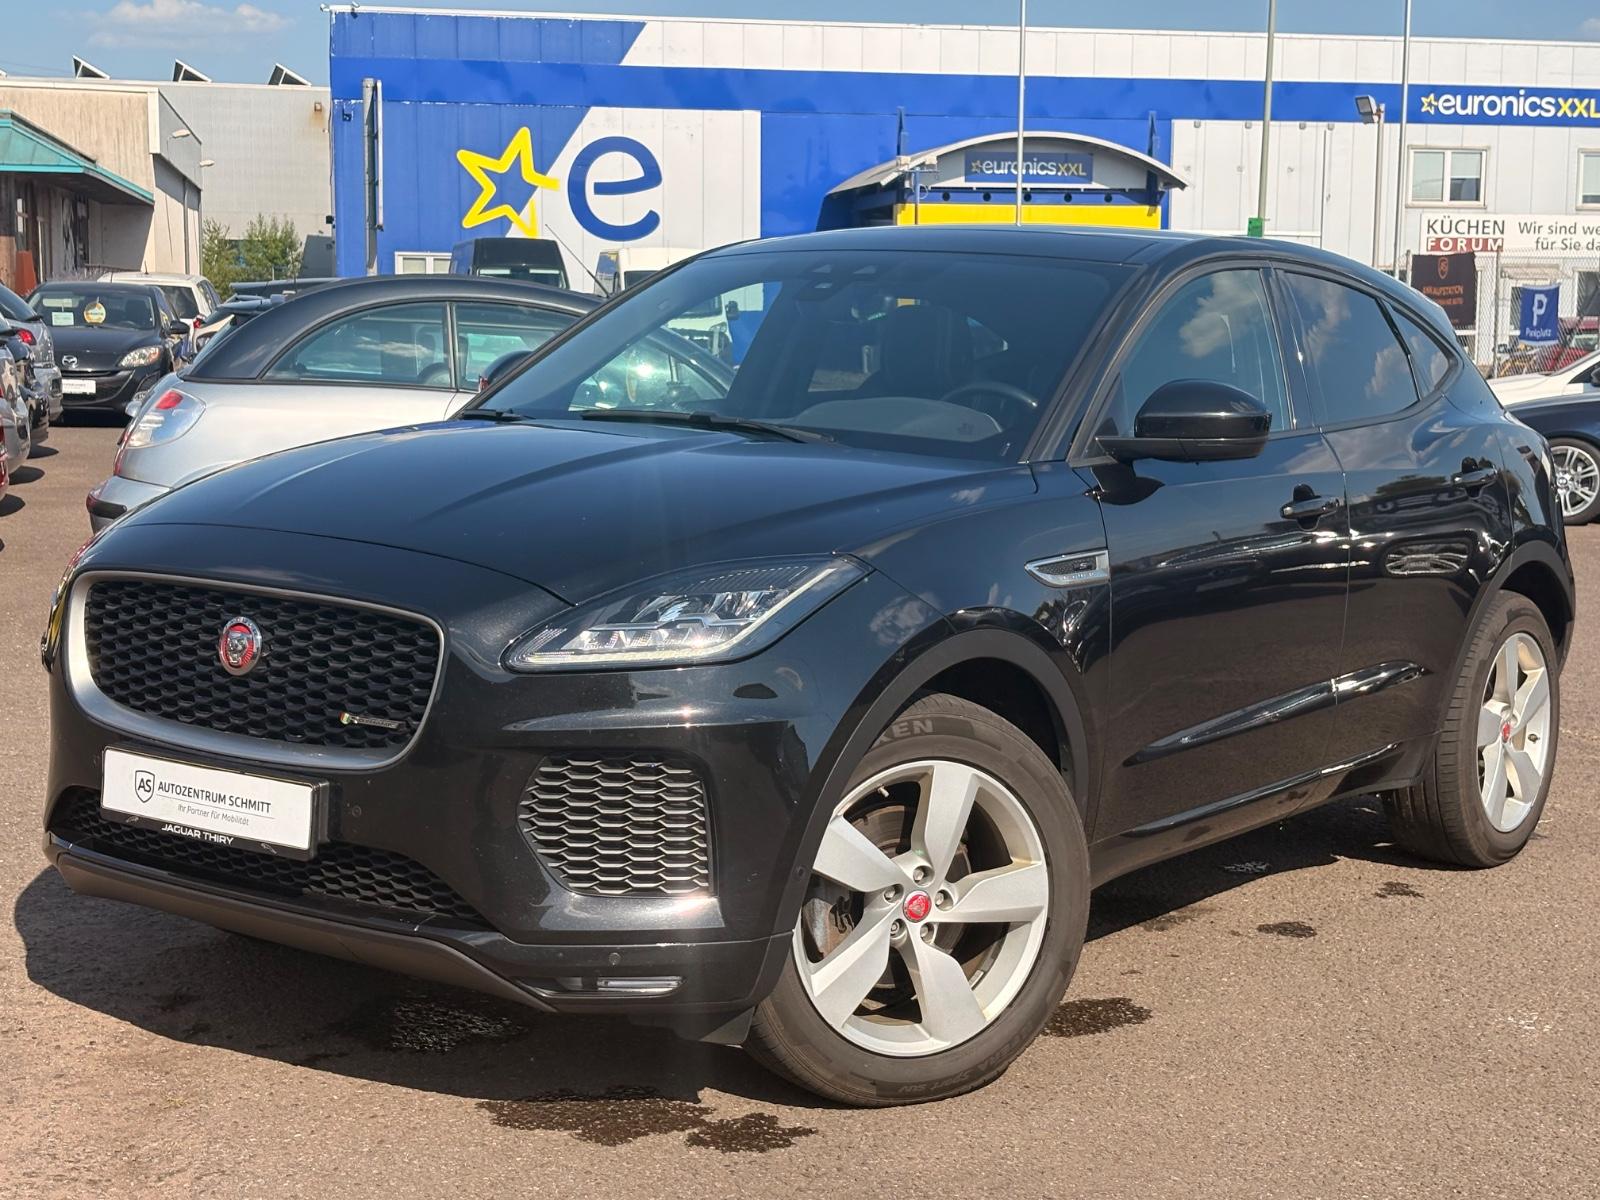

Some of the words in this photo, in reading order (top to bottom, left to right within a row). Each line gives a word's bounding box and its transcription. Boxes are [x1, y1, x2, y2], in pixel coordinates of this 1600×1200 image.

[1427, 215, 1506, 235] KÜCHEN
[1518, 221, 1543, 234] Wir
[1547, 221, 1577, 235] sind
[1427, 237, 1503, 251] FORUM
[1535, 236, 1556, 250] für
[1560, 238, 1581, 251] Sie
[1532, 293, 1548, 327] P
[137, 777, 152, 793] AS
[157, 781, 227, 805] AUTOZENTRUM
[228, 795, 272, 813] SCHMITT
[186, 805, 210, 818] Partner
[210, 810, 220, 820] für
[162, 823, 201, 839] JAGUAR
[202, 832, 234, 845] THIRY
